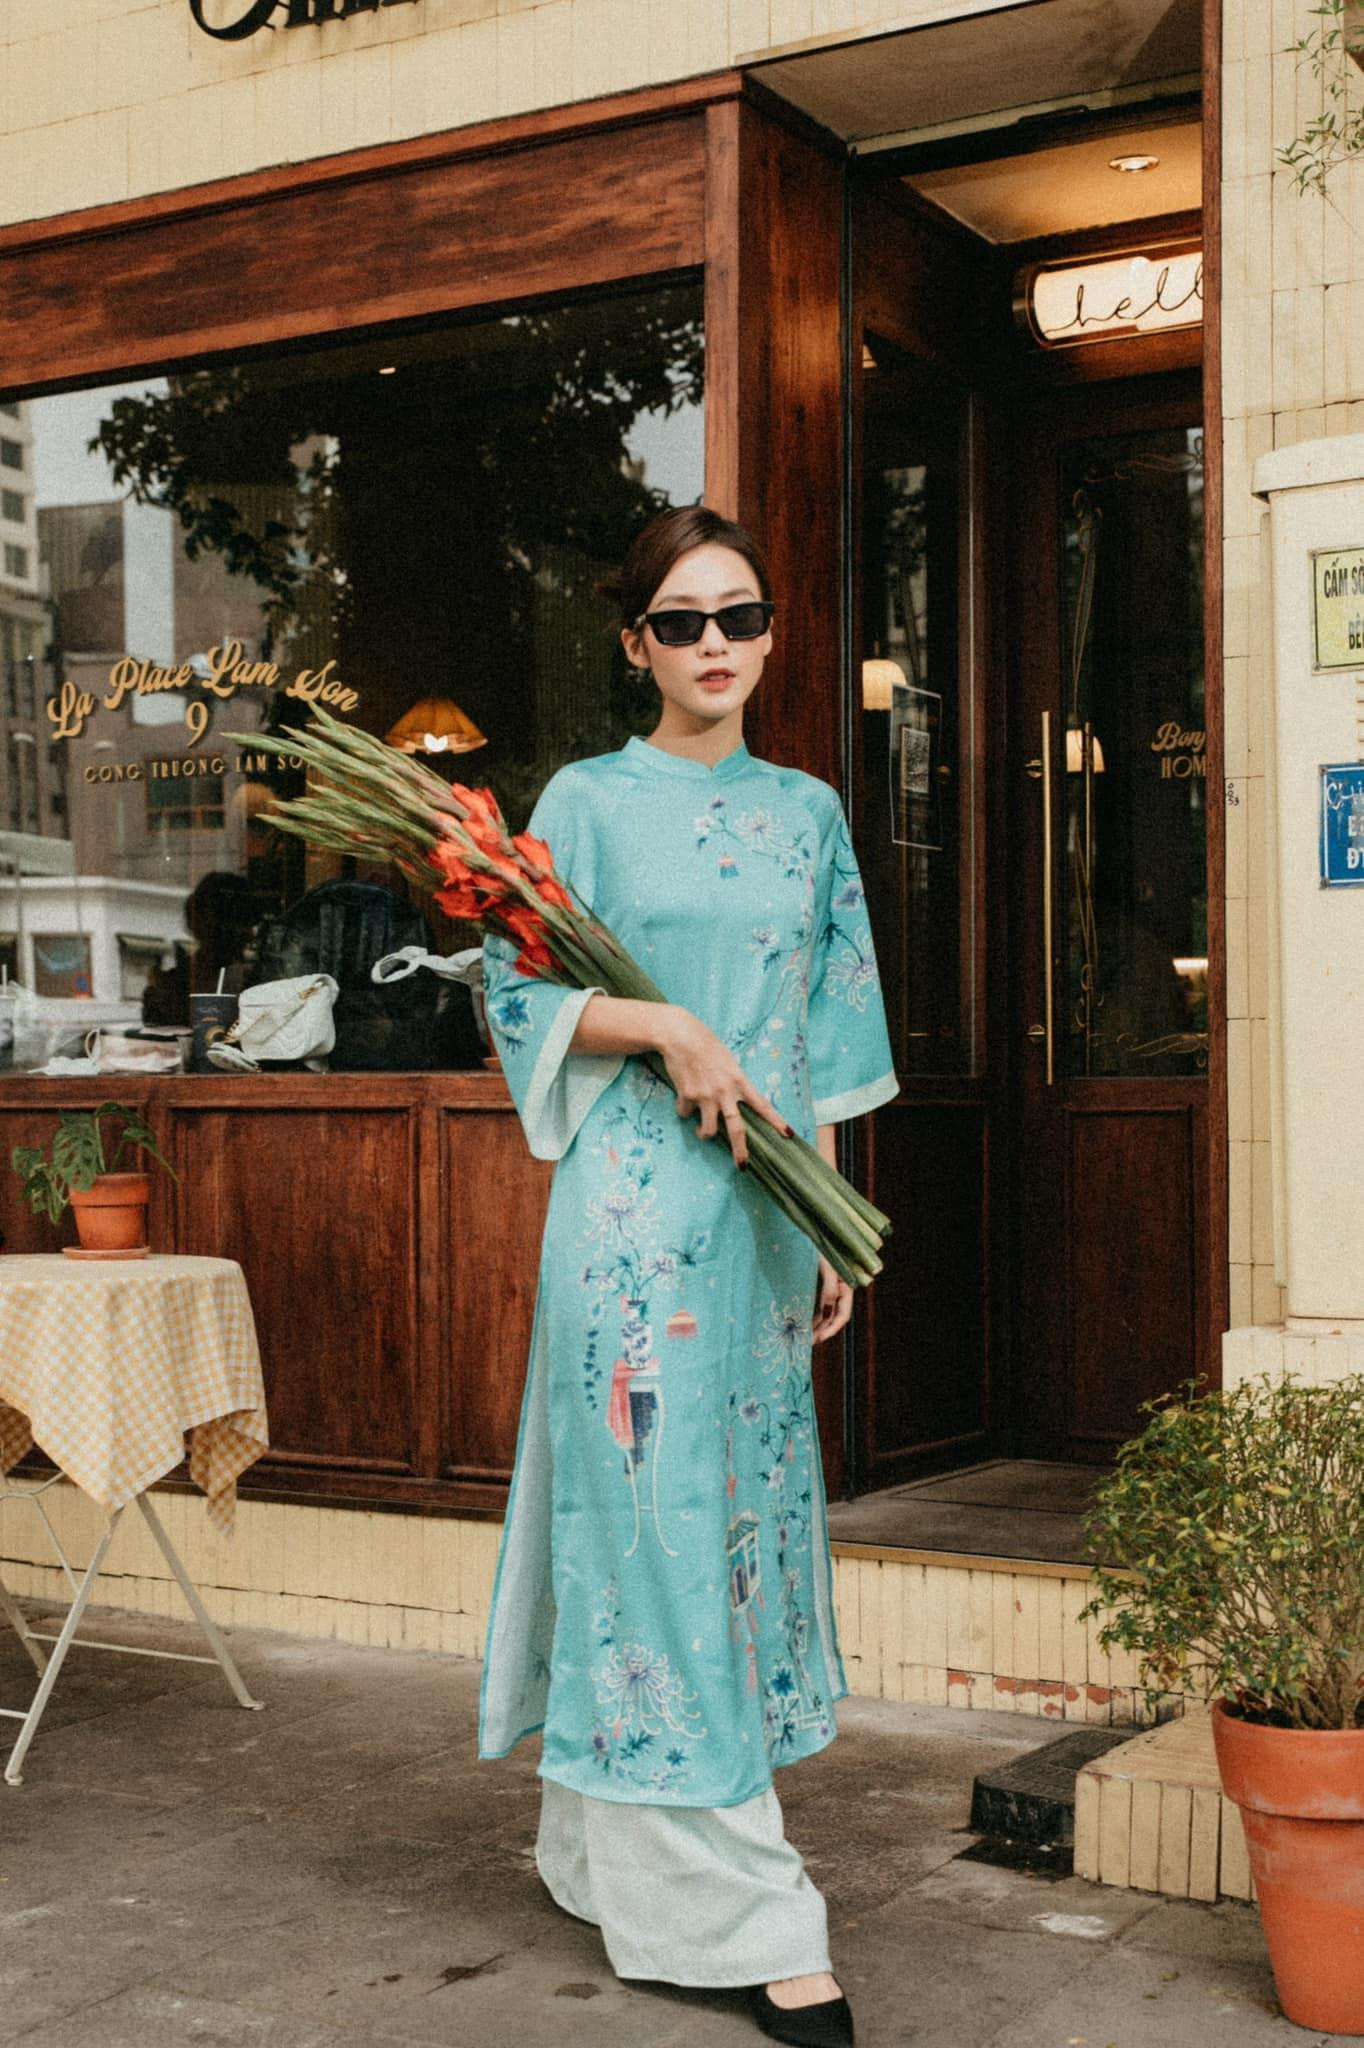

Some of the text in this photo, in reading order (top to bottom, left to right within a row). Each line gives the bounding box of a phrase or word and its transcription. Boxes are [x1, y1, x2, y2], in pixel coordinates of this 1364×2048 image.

[1324, 557, 1348, 598] CẤM
[47, 640, 358, 740] La Place Lam Son
[186, 701, 208, 747] 9
[151, 757, 225, 778] TRUONG
[235, 754, 266, 773] LAM
